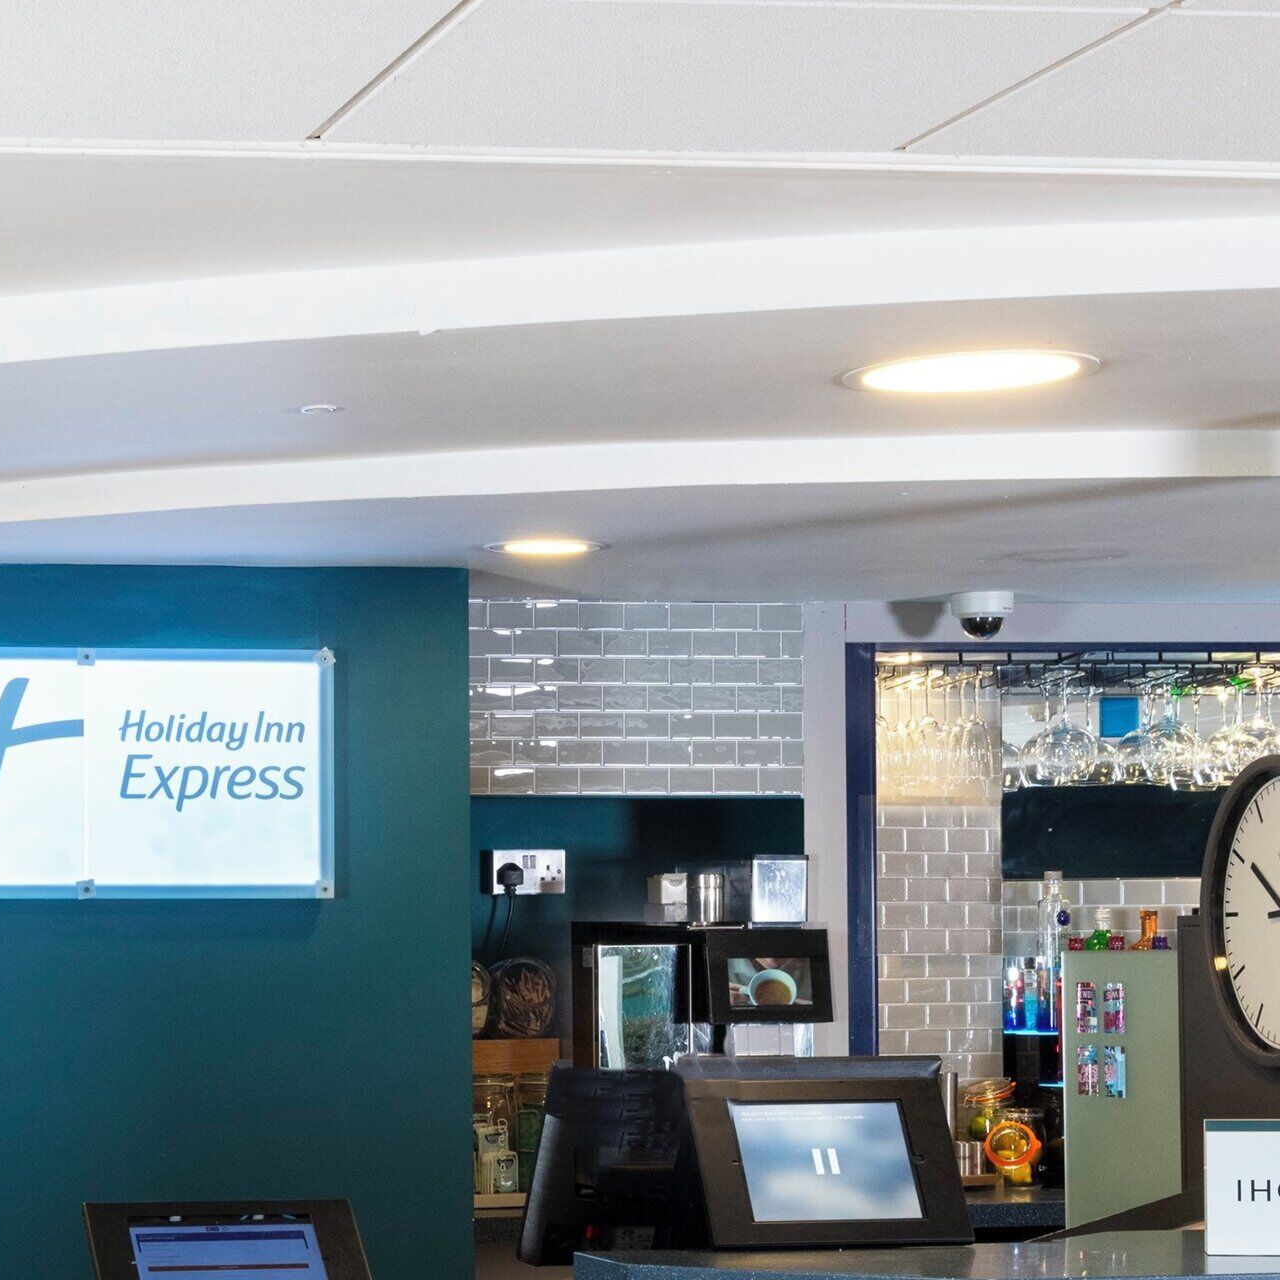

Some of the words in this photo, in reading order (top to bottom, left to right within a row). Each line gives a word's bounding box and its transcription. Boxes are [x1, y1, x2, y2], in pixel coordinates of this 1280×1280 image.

[118, 709, 249, 750] Holiday
[254, 711, 305, 743] Inn
[120, 754, 306, 812] Express
